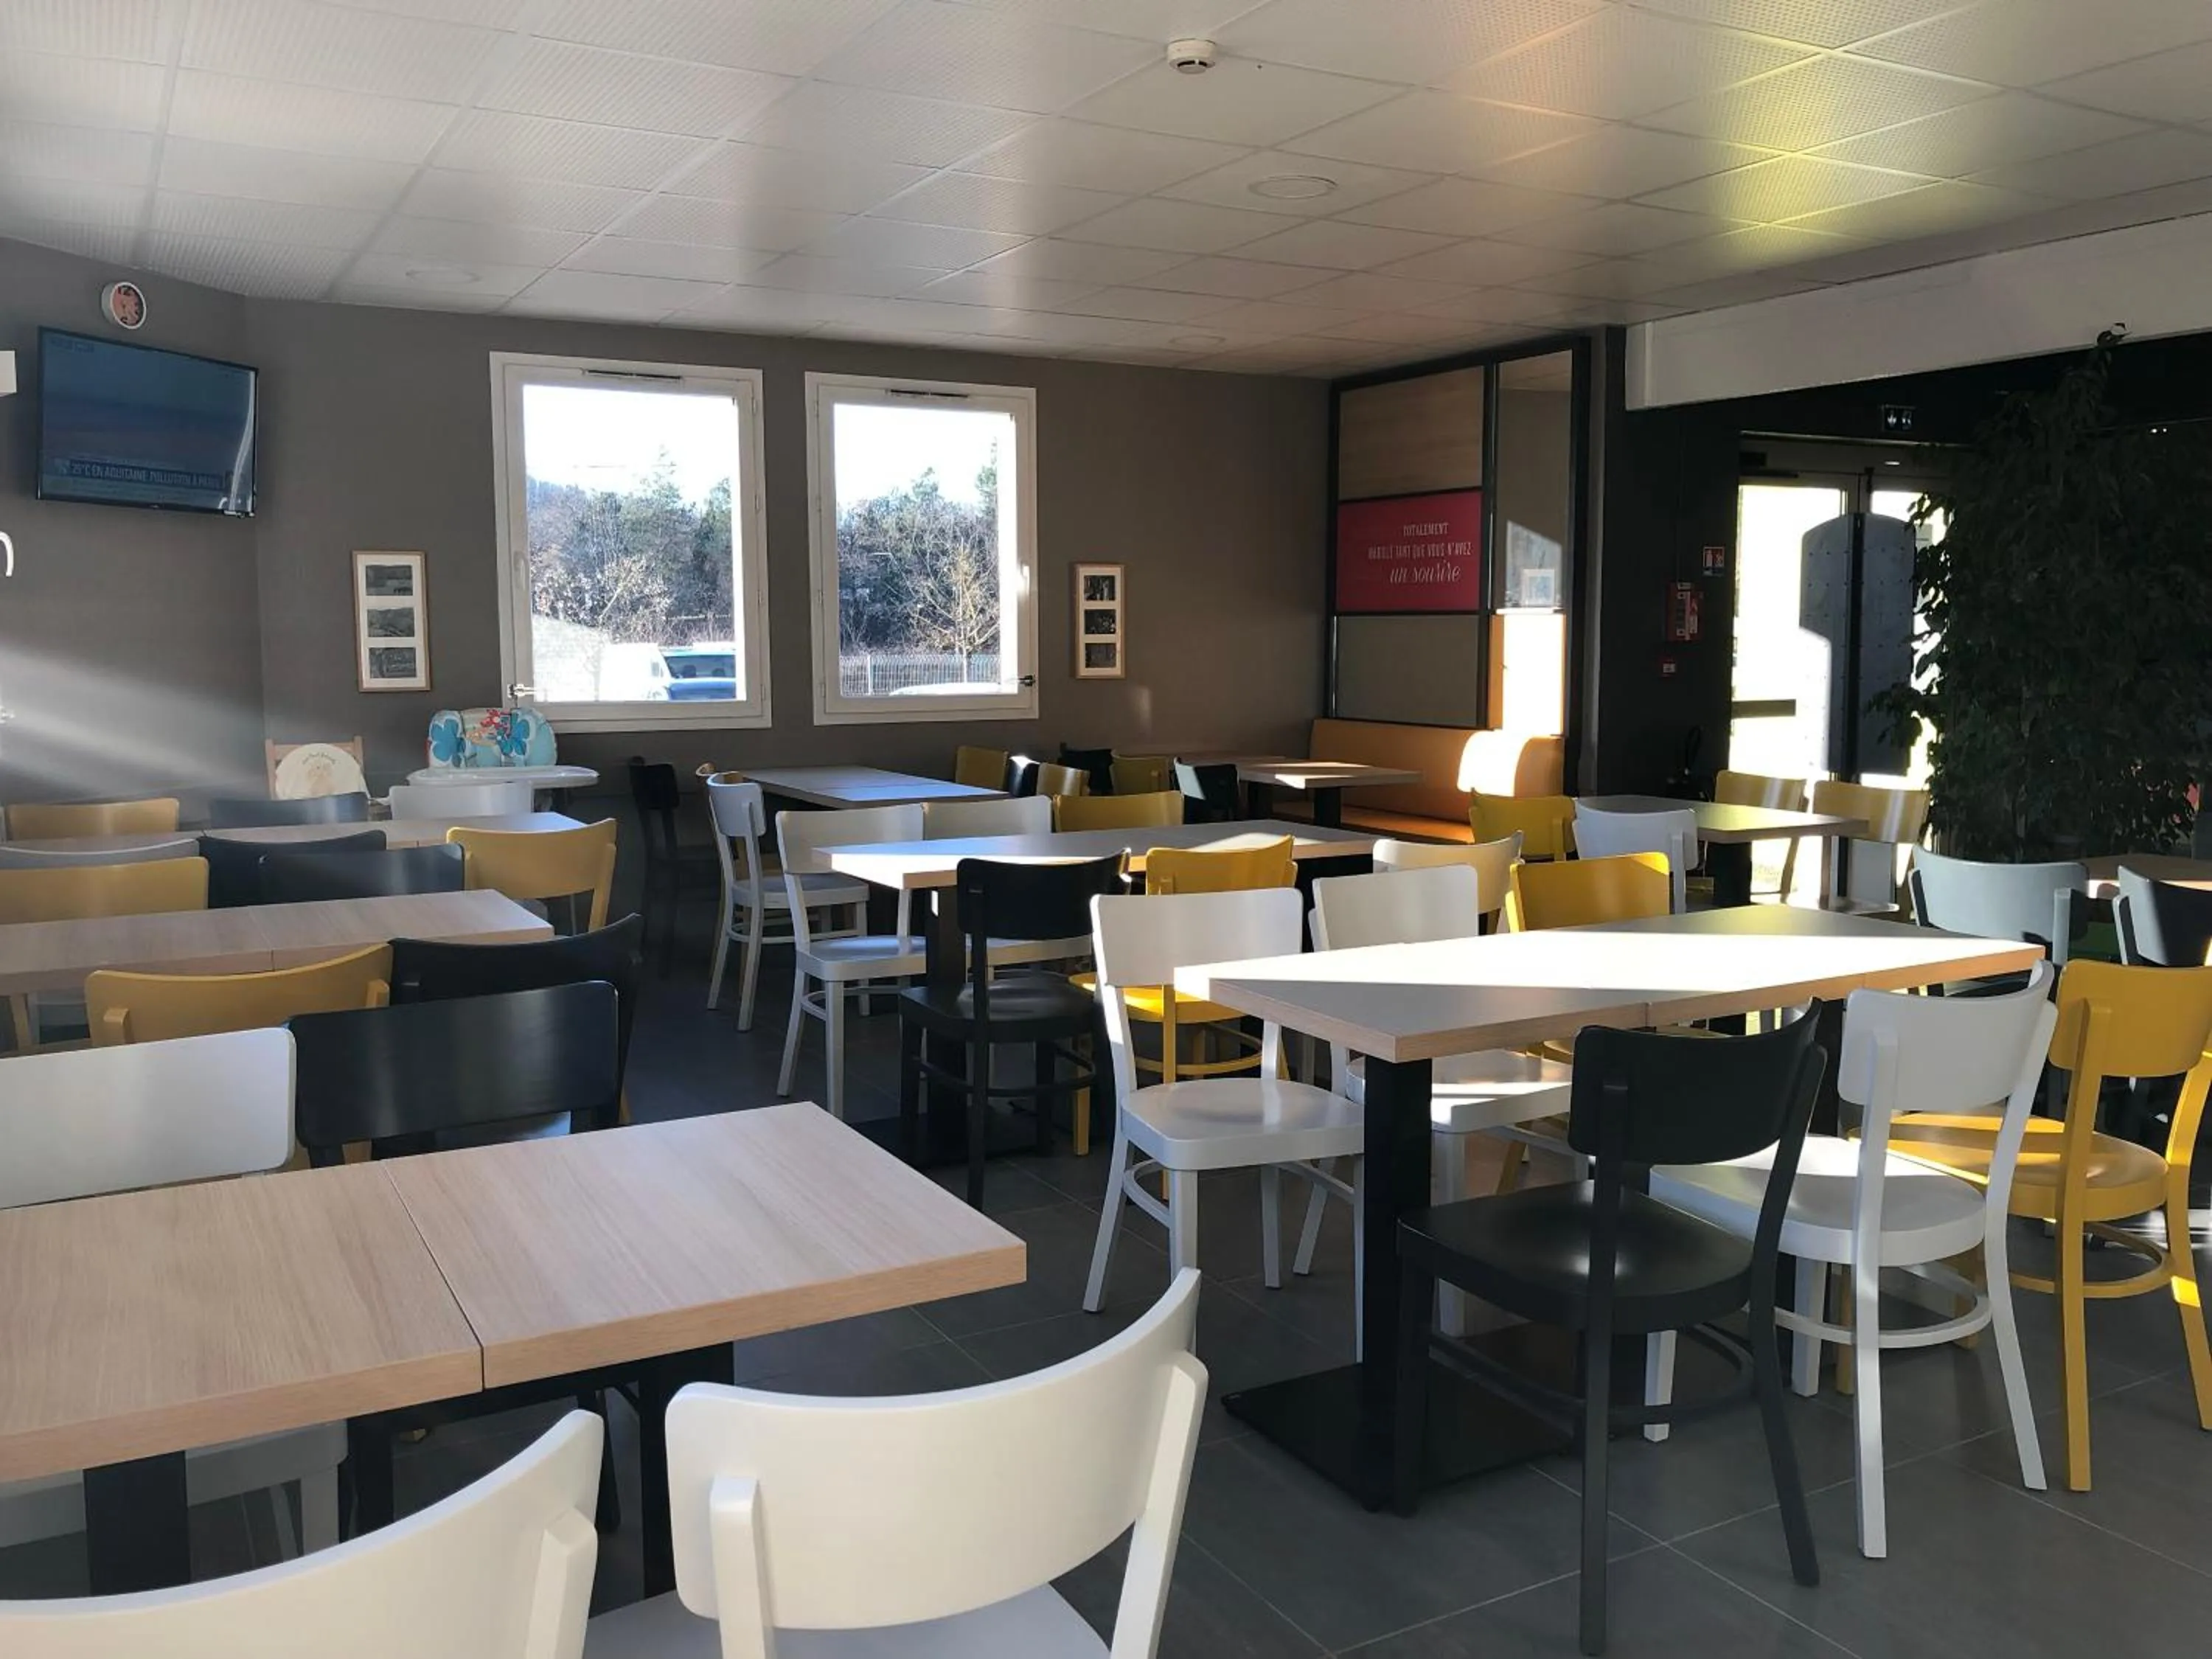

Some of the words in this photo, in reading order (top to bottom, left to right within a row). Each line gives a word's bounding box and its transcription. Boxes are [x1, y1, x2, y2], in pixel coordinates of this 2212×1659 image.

[1403, 522, 1449, 536] TOTALEMENT
[1427, 542, 1444, 557] VOUS
[1447, 542, 1472, 555] N'AVEZ
[1390, 566, 1409, 584] un
[1411, 559, 1461, 584] sourire
